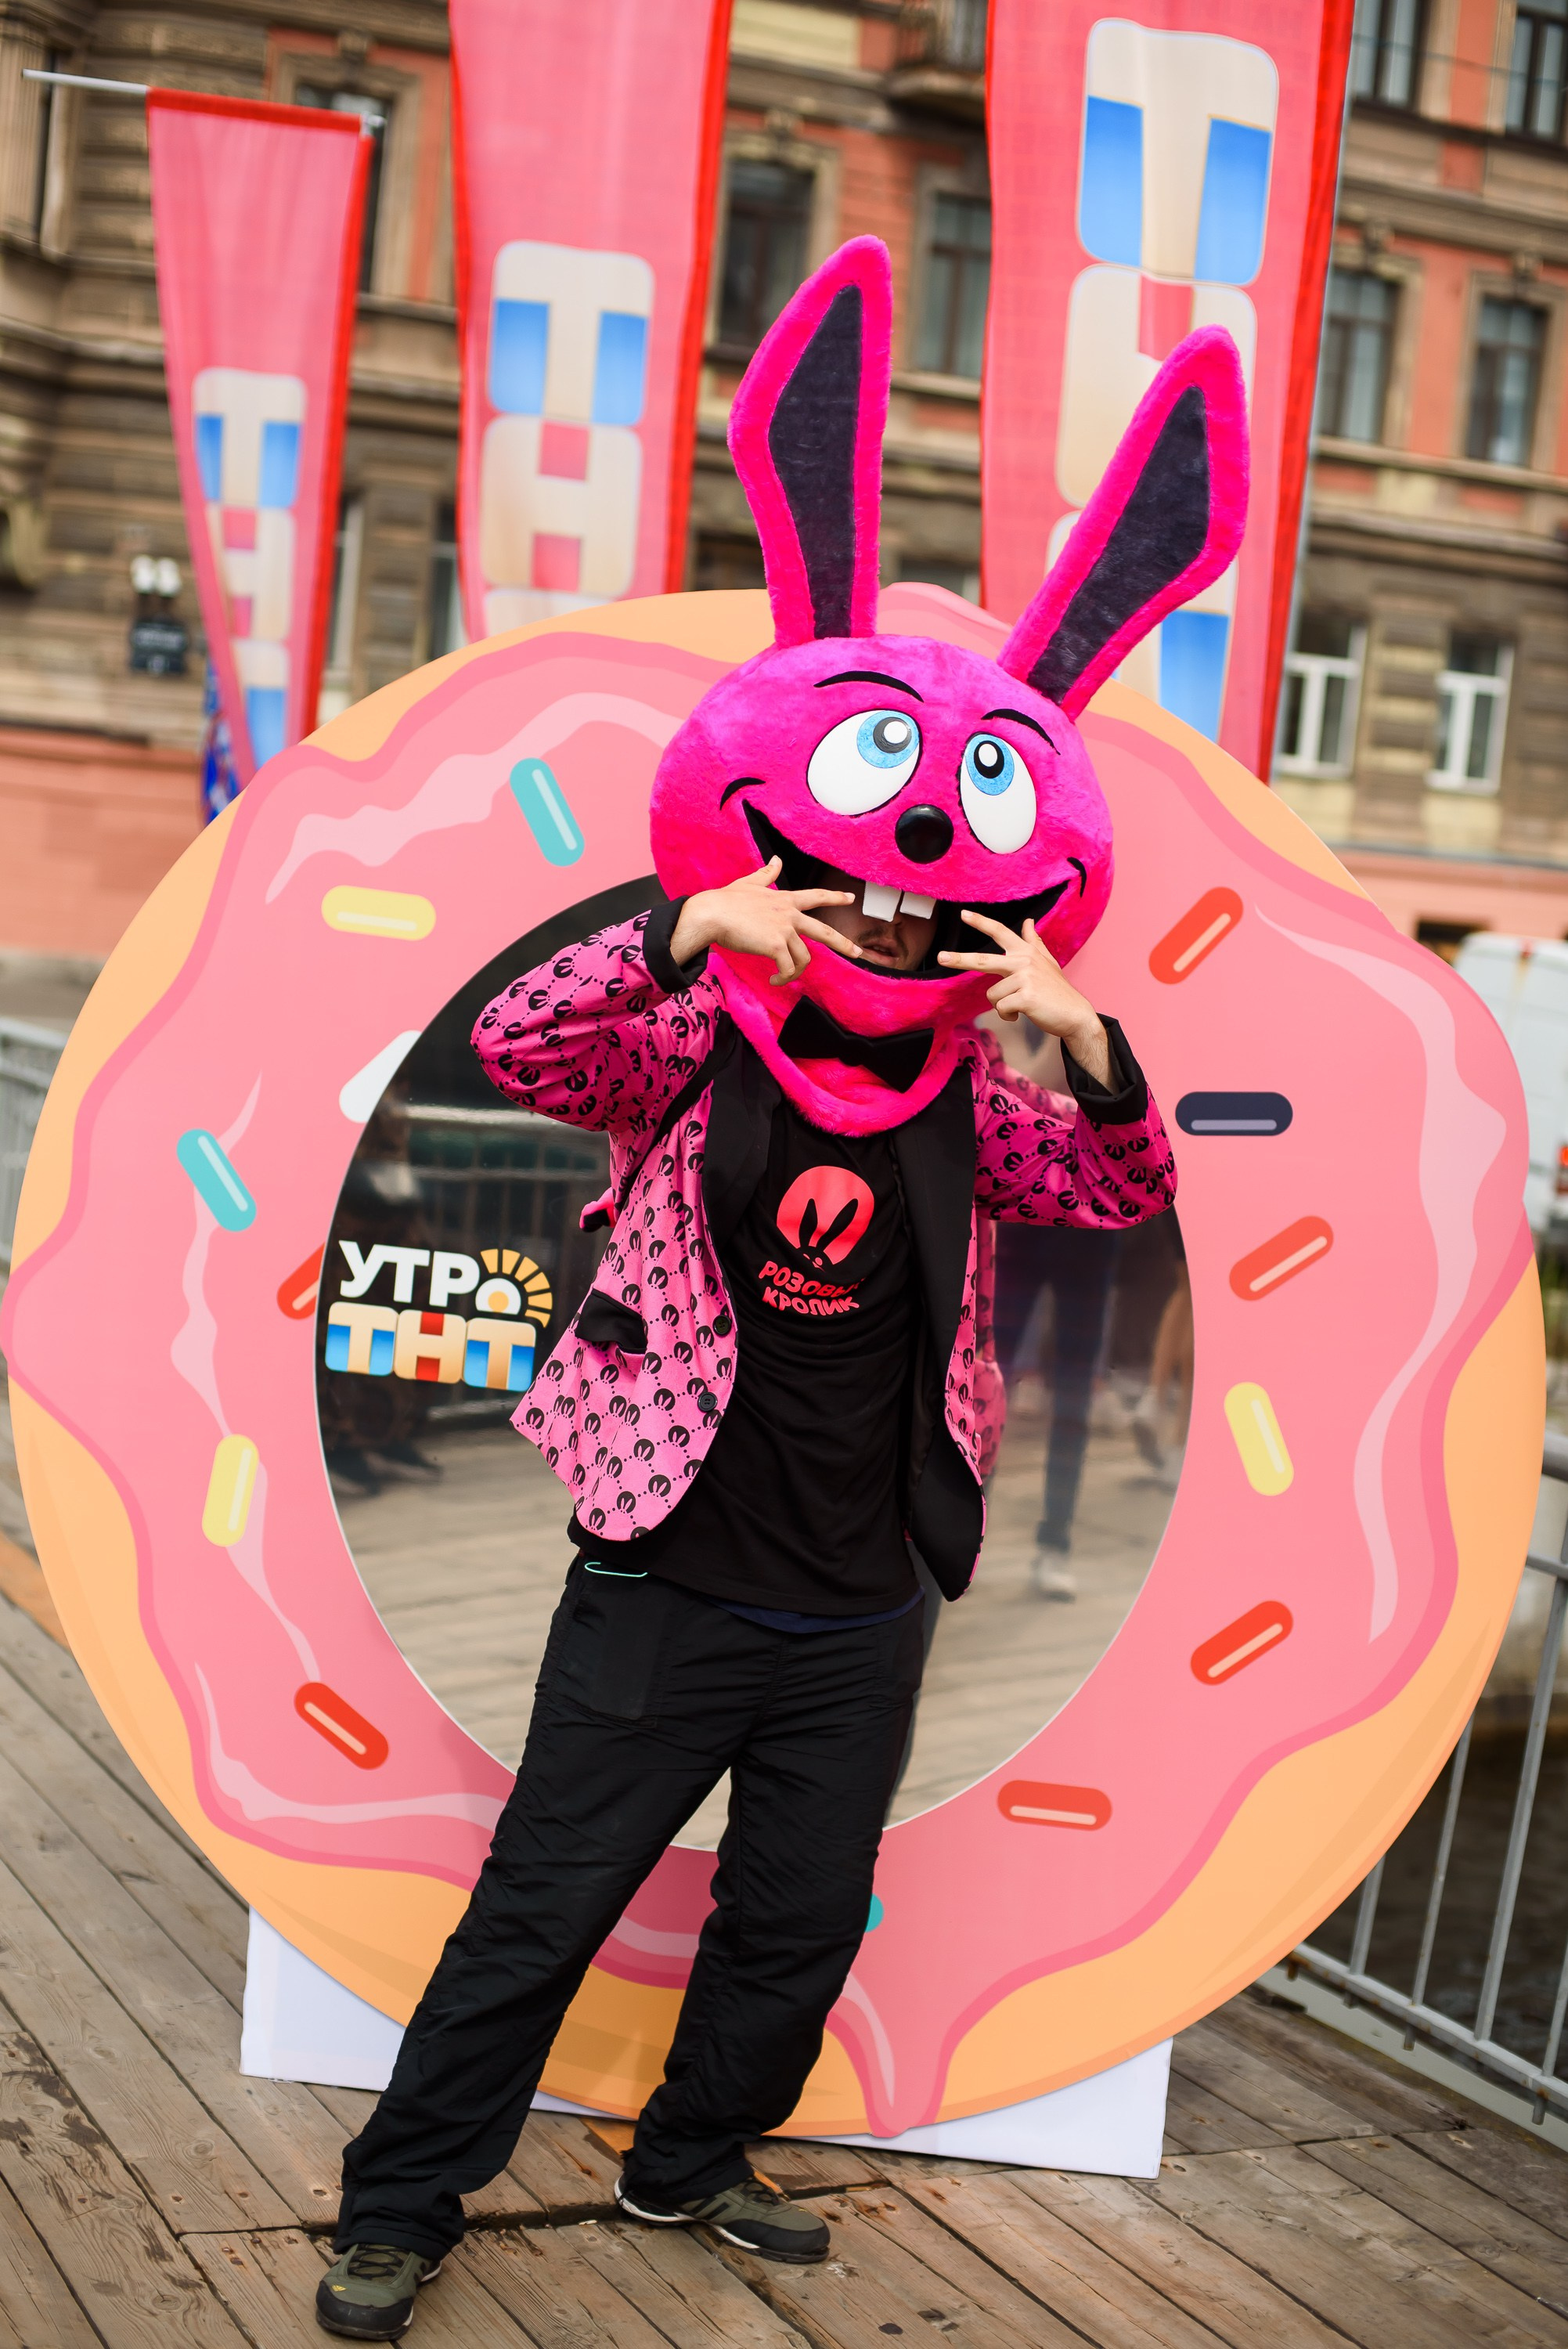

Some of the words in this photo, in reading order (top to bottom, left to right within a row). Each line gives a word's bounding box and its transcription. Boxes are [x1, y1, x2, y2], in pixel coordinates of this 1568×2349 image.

[480, 239, 656, 638] ТН
[338, 1239, 523, 1315] УТРО
[758, 1261, 867, 1298] РОЗОВЫ
[762, 1286, 860, 1316] КРОЛИК
[325, 1301, 537, 1392] ТНТ
